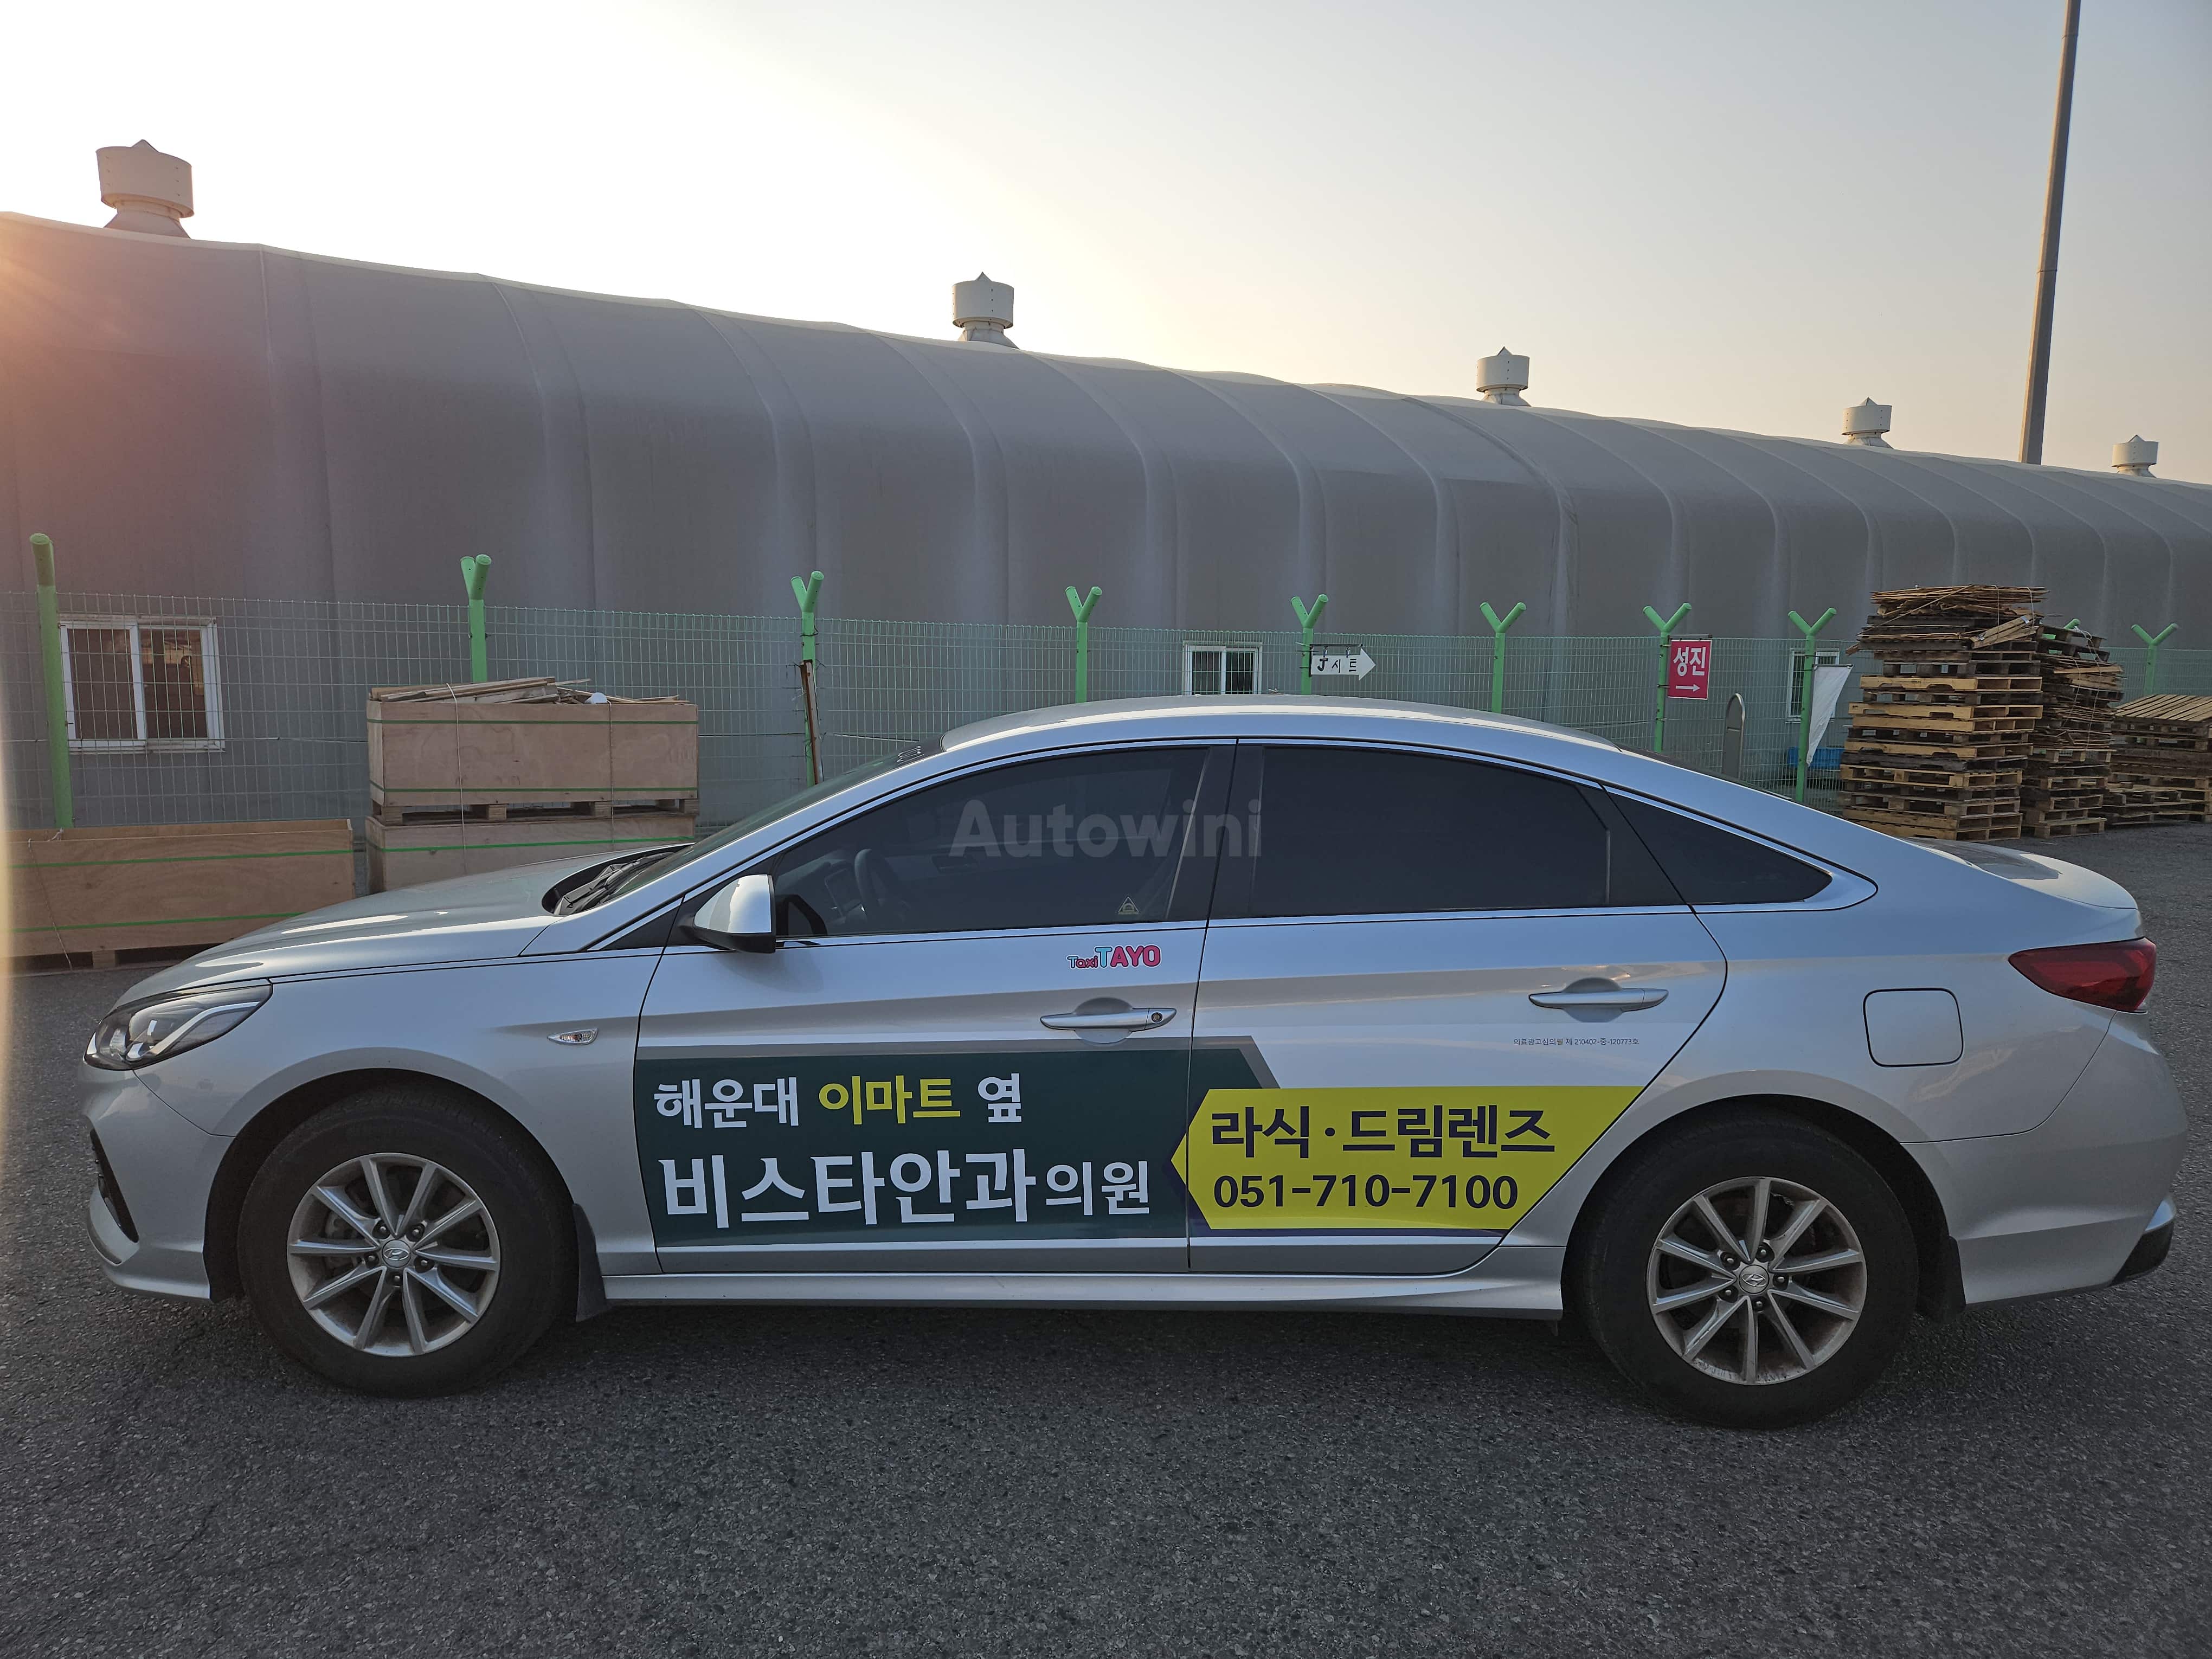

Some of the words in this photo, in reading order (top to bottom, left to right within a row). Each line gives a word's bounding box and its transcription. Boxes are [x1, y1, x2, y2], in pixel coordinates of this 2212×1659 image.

[1673, 647, 1706, 677] 성진
[1513, 1038, 1563, 1046] 의료광고심의필
[1565, 1038, 1572, 1046] 제
[654, 1077, 799, 1128] 해운대
[819, 1075, 961, 1125] 이마트
[978, 1073, 1022, 1123] 옆
[1214, 1174, 1518, 1210] 051-710-7100
